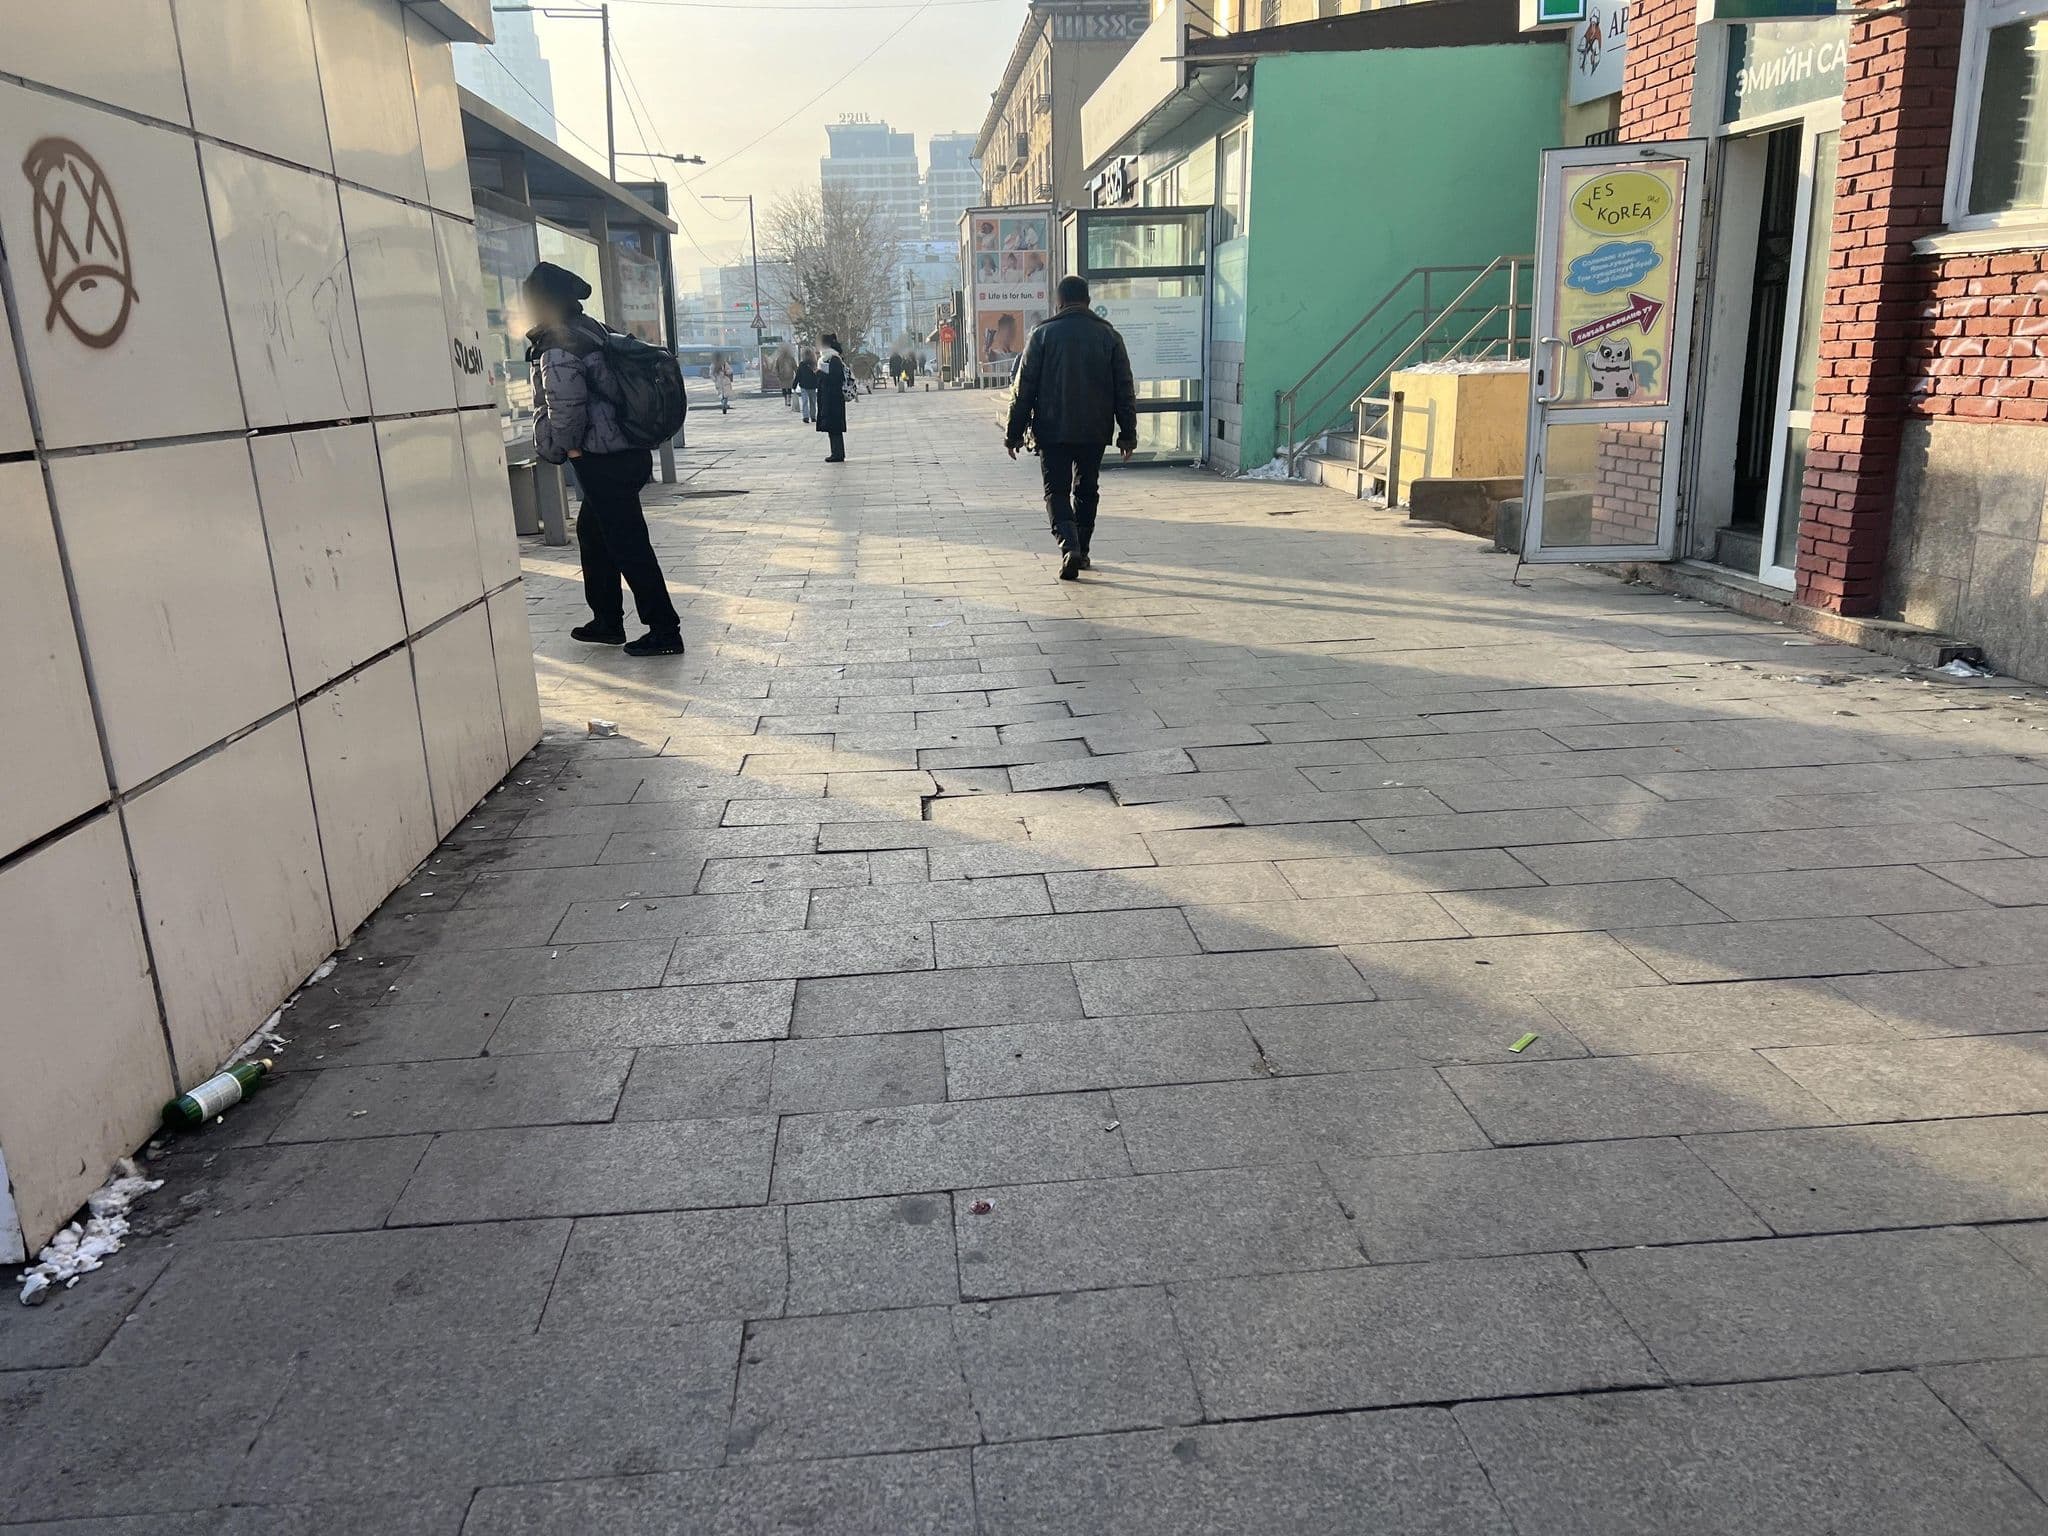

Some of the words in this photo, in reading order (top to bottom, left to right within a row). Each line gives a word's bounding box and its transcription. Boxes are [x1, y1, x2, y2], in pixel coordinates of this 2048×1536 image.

[1734, 46, 1813, 98] ЭМИЙН
[1582, 183, 1615, 211] YES
[1597, 202, 1652, 225] KOREA
[988, 291, 1001, 300] Life
[1009, 291, 1020, 299] for
